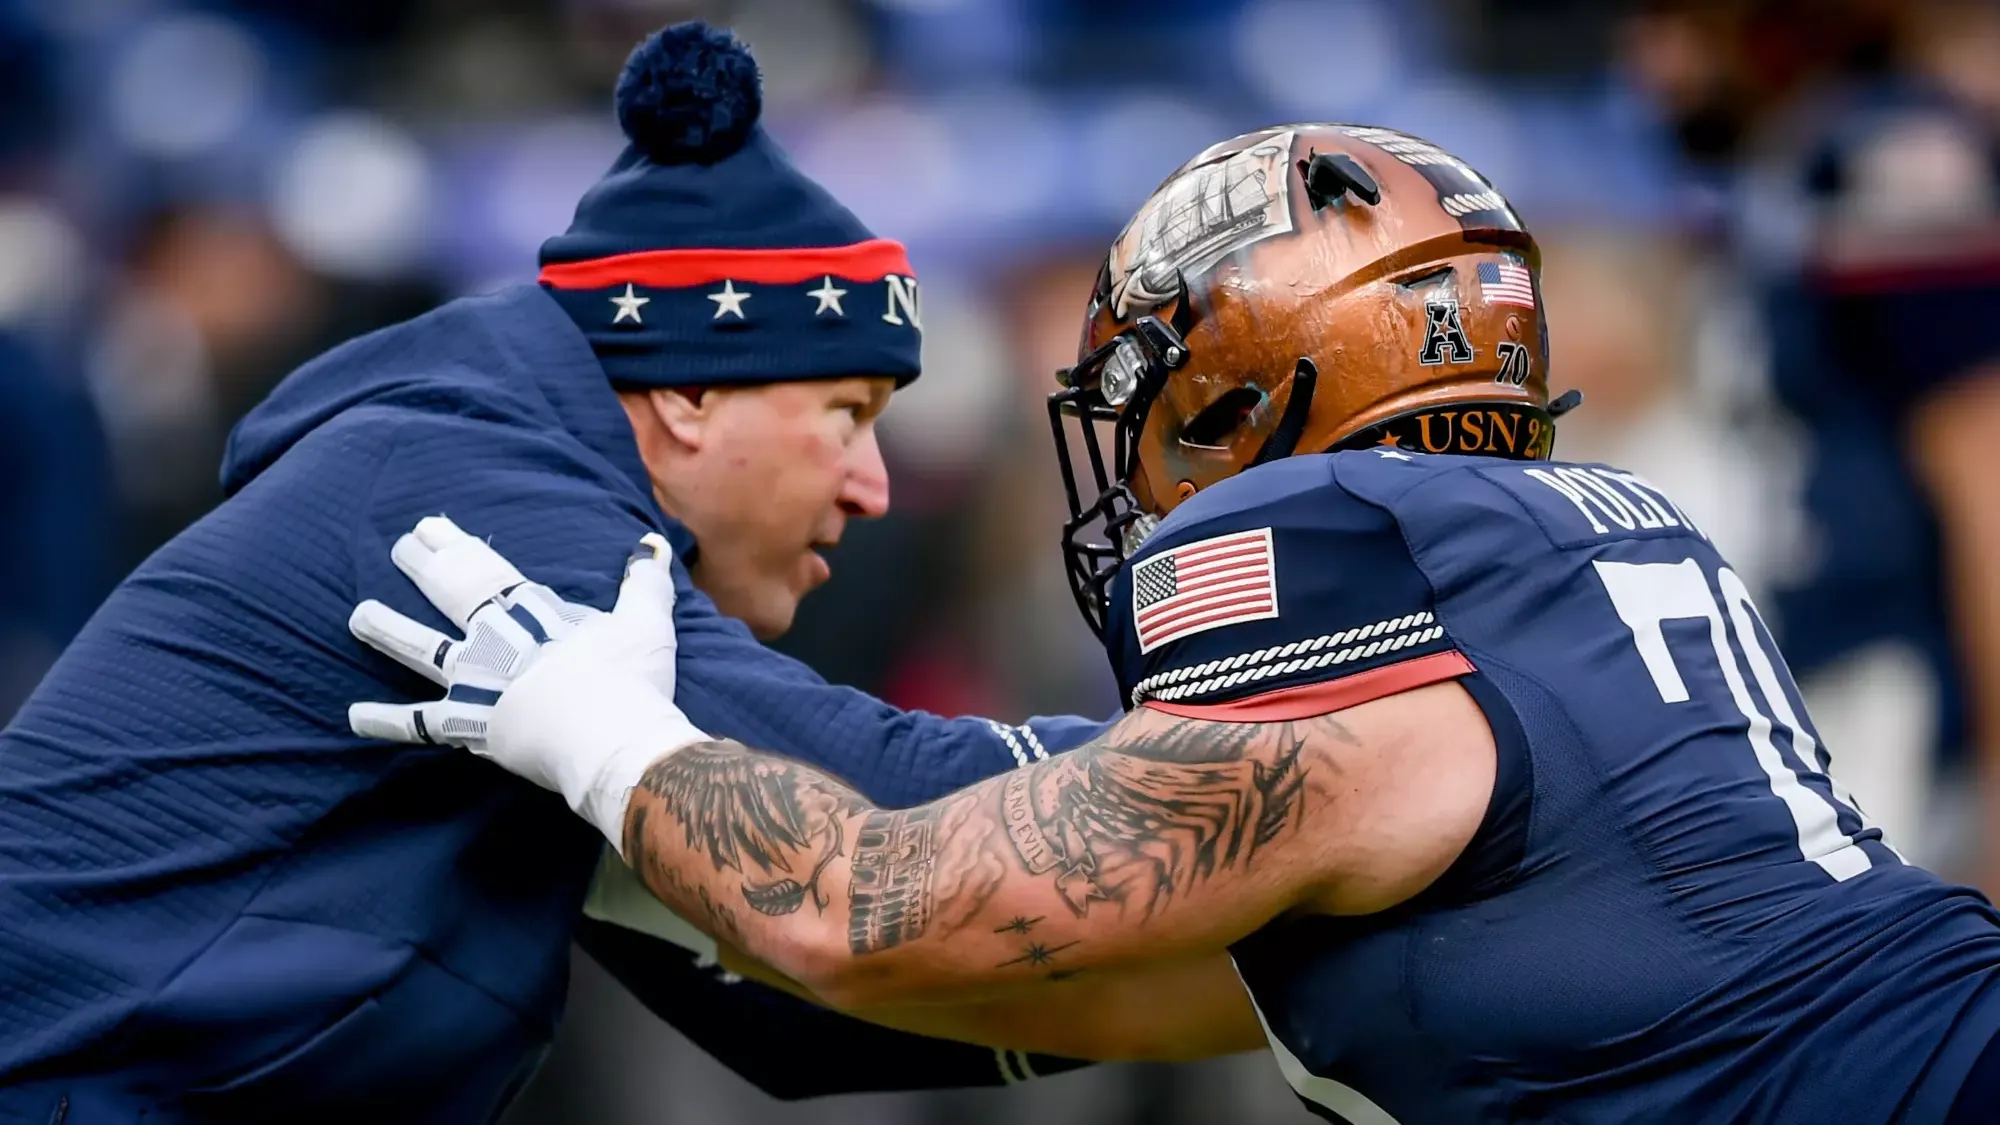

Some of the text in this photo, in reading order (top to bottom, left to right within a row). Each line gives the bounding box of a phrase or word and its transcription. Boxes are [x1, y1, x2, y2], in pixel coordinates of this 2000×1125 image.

[1495, 342, 1531, 386] 70
[1415, 411, 1522, 453] USN
[1591, 557, 1908, 883] 70
[1009, 795, 1026, 821] NO
[1016, 823, 1044, 868] EVIL
